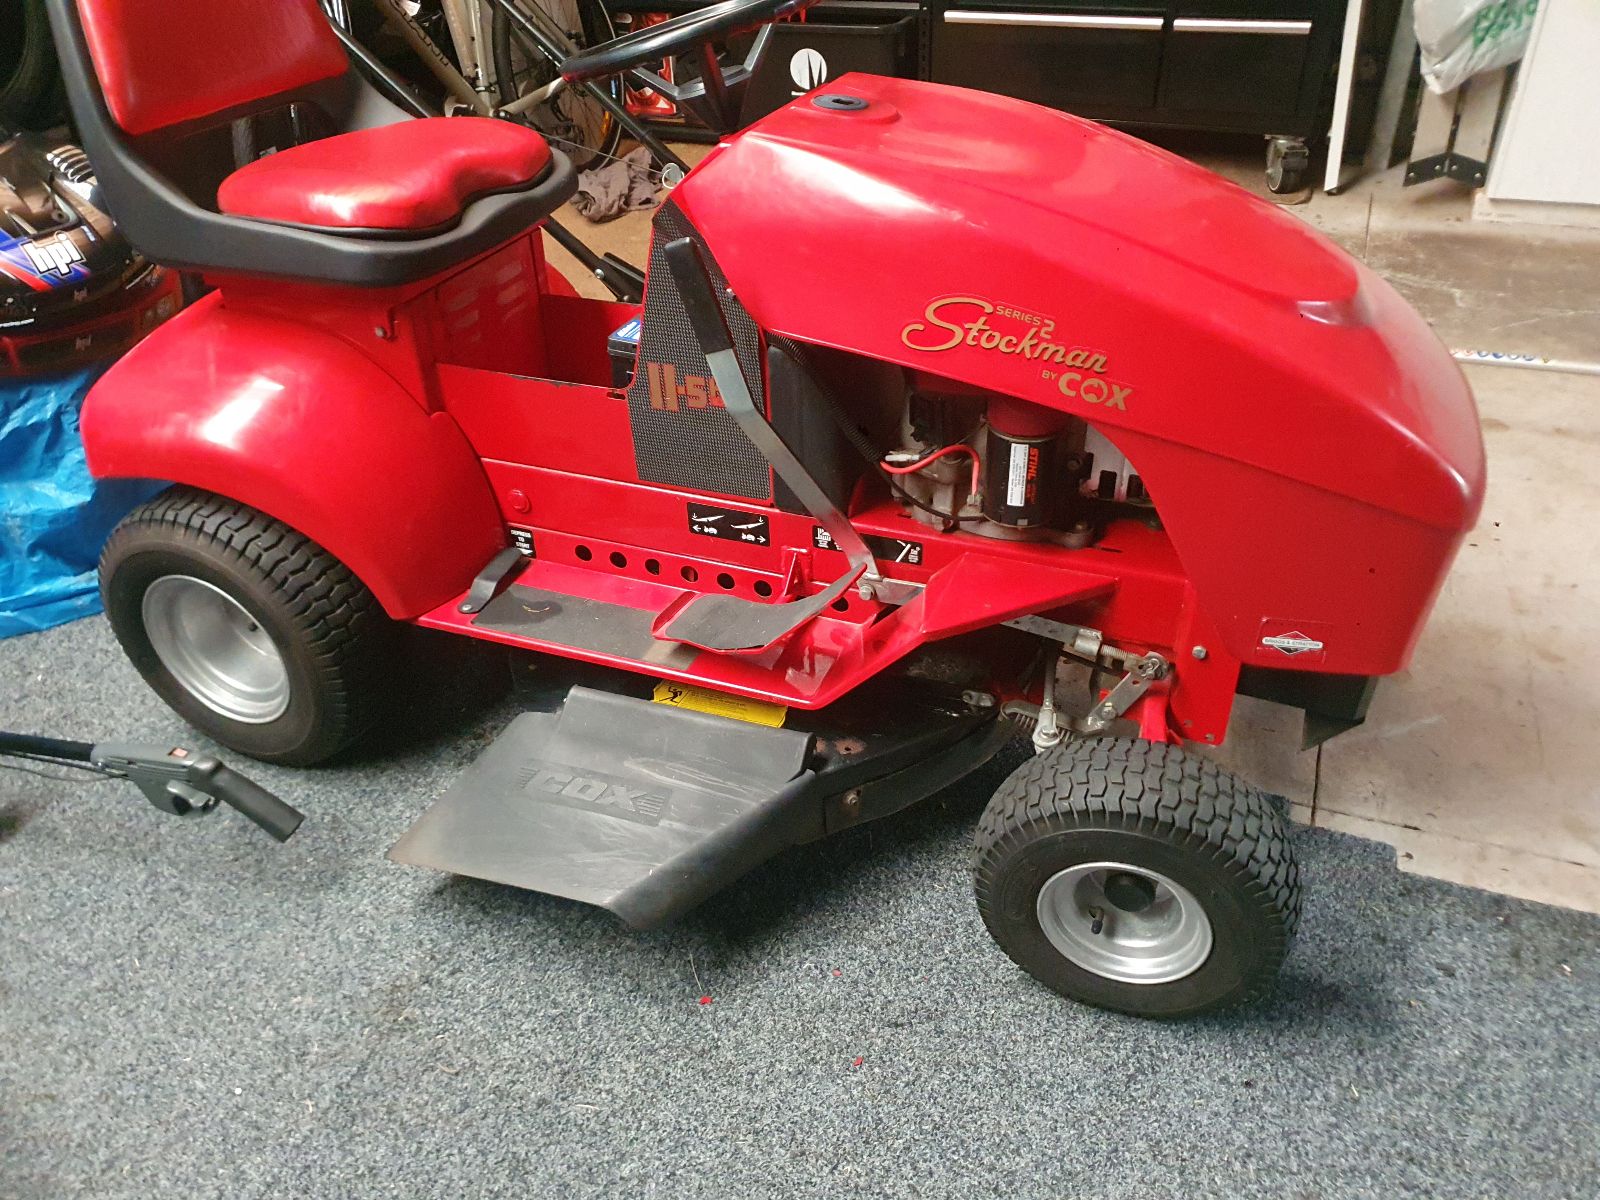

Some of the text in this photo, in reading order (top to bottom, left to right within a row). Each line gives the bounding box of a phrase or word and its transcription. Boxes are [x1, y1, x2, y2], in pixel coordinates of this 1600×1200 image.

[21, 232, 85, 276] hpi
[901, 296, 1109, 373] Stockman
[995, 305, 1056, 339] SERIES 2
[1041, 369, 1133, 411] BY COX
[1027, 447, 1039, 480] STIHL
[526, 770, 648, 812] COX
